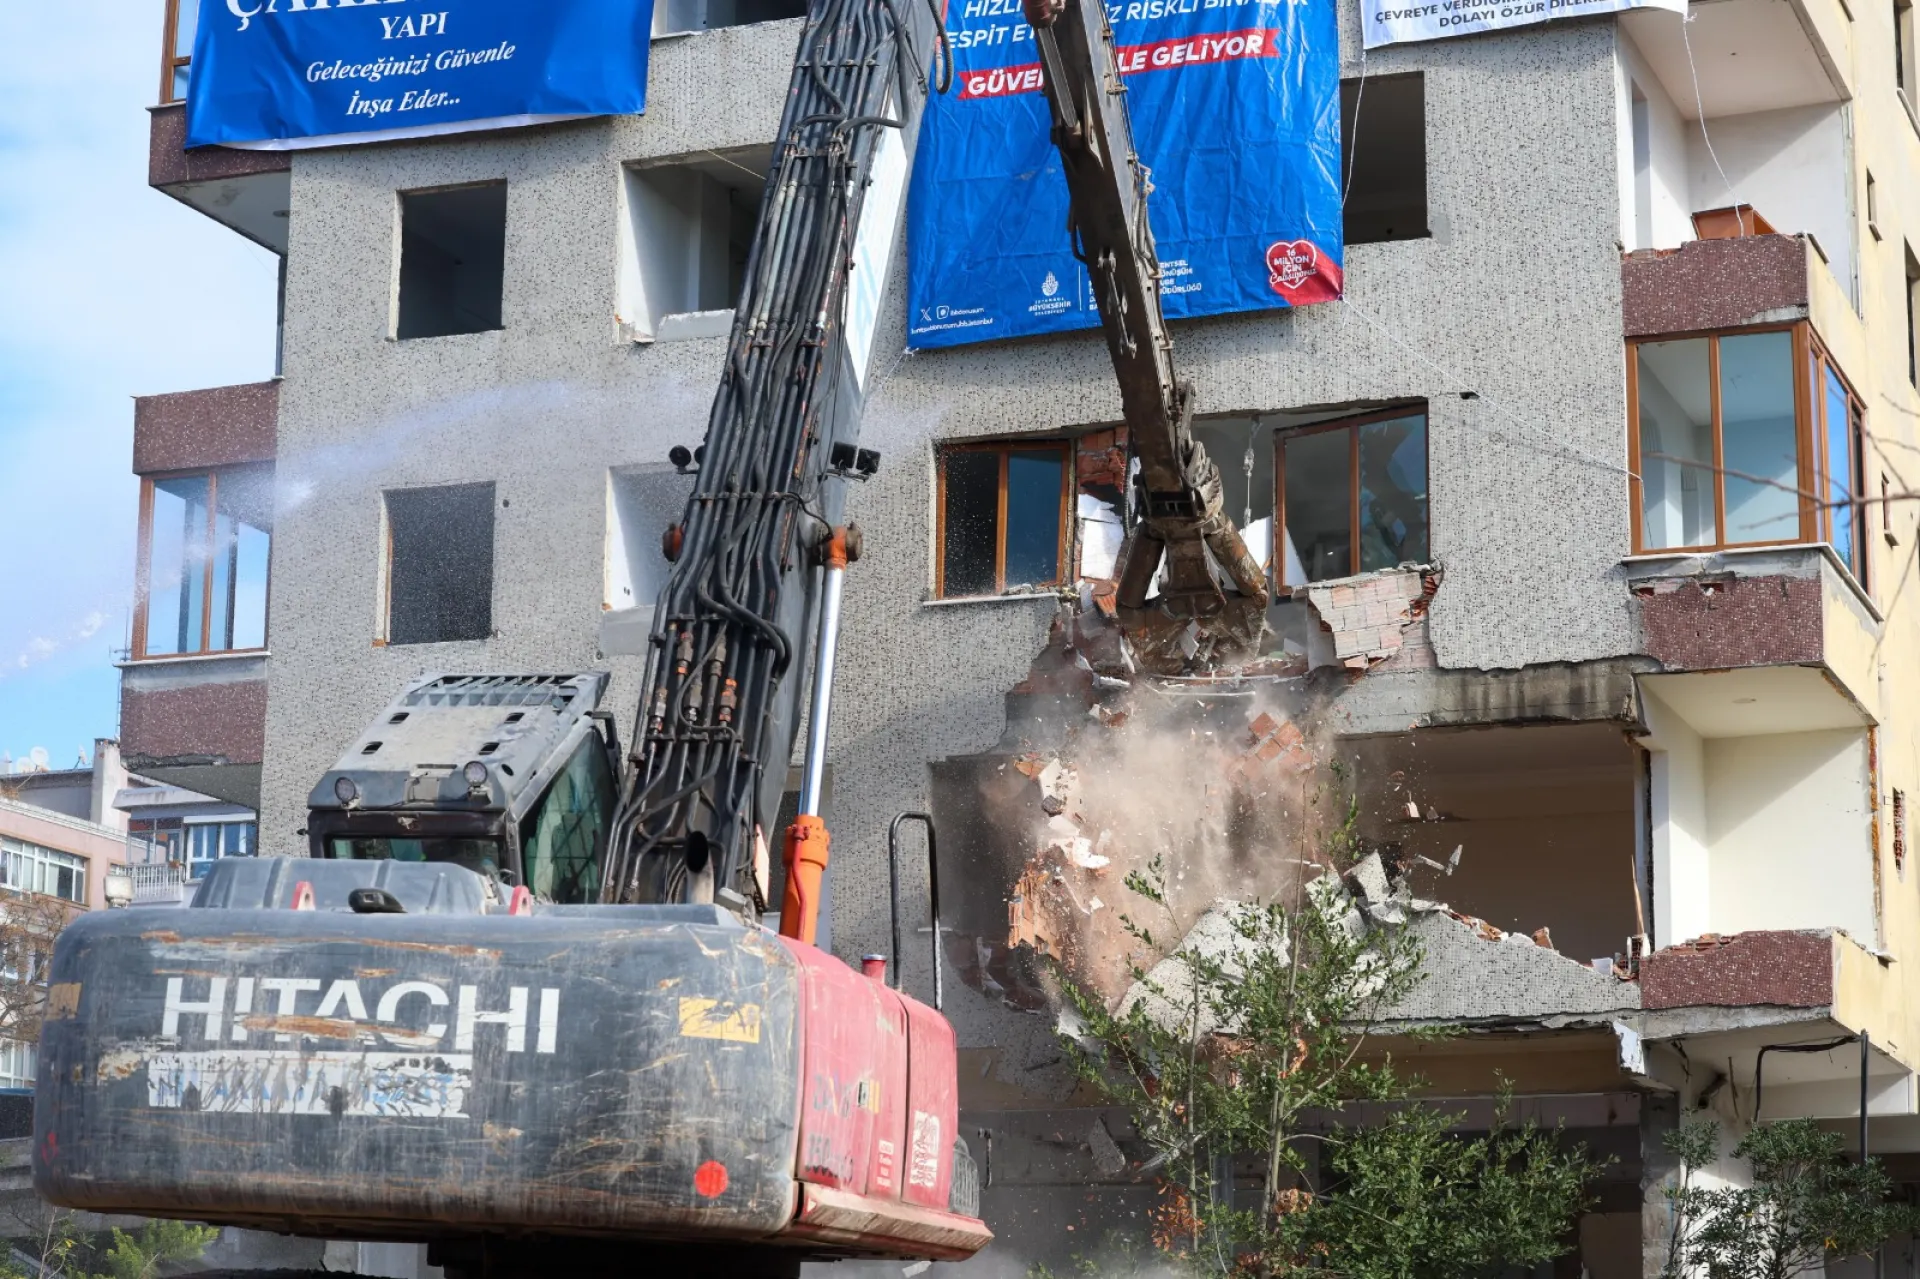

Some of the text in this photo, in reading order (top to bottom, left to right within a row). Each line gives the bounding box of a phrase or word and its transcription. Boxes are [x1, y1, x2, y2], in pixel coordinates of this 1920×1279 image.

[379, 11, 449, 40] YAPI
[1375, 4, 1438, 24] ÇEVREYE
[1439, 10, 1495, 28] DOLAYI
[1501, 2, 1545, 18] ÖZÜR
[948, 24, 1010, 49] ESPİT
[306, 41, 516, 83] Geleceğinizi Güvenle
[1115, 35, 1264, 73] LE GELİYOR
[345, 89, 461, 119] İnşa Eder...
[1158, 259, 1189, 269] ENTSEL
[161, 977, 560, 1054] HITACHI
